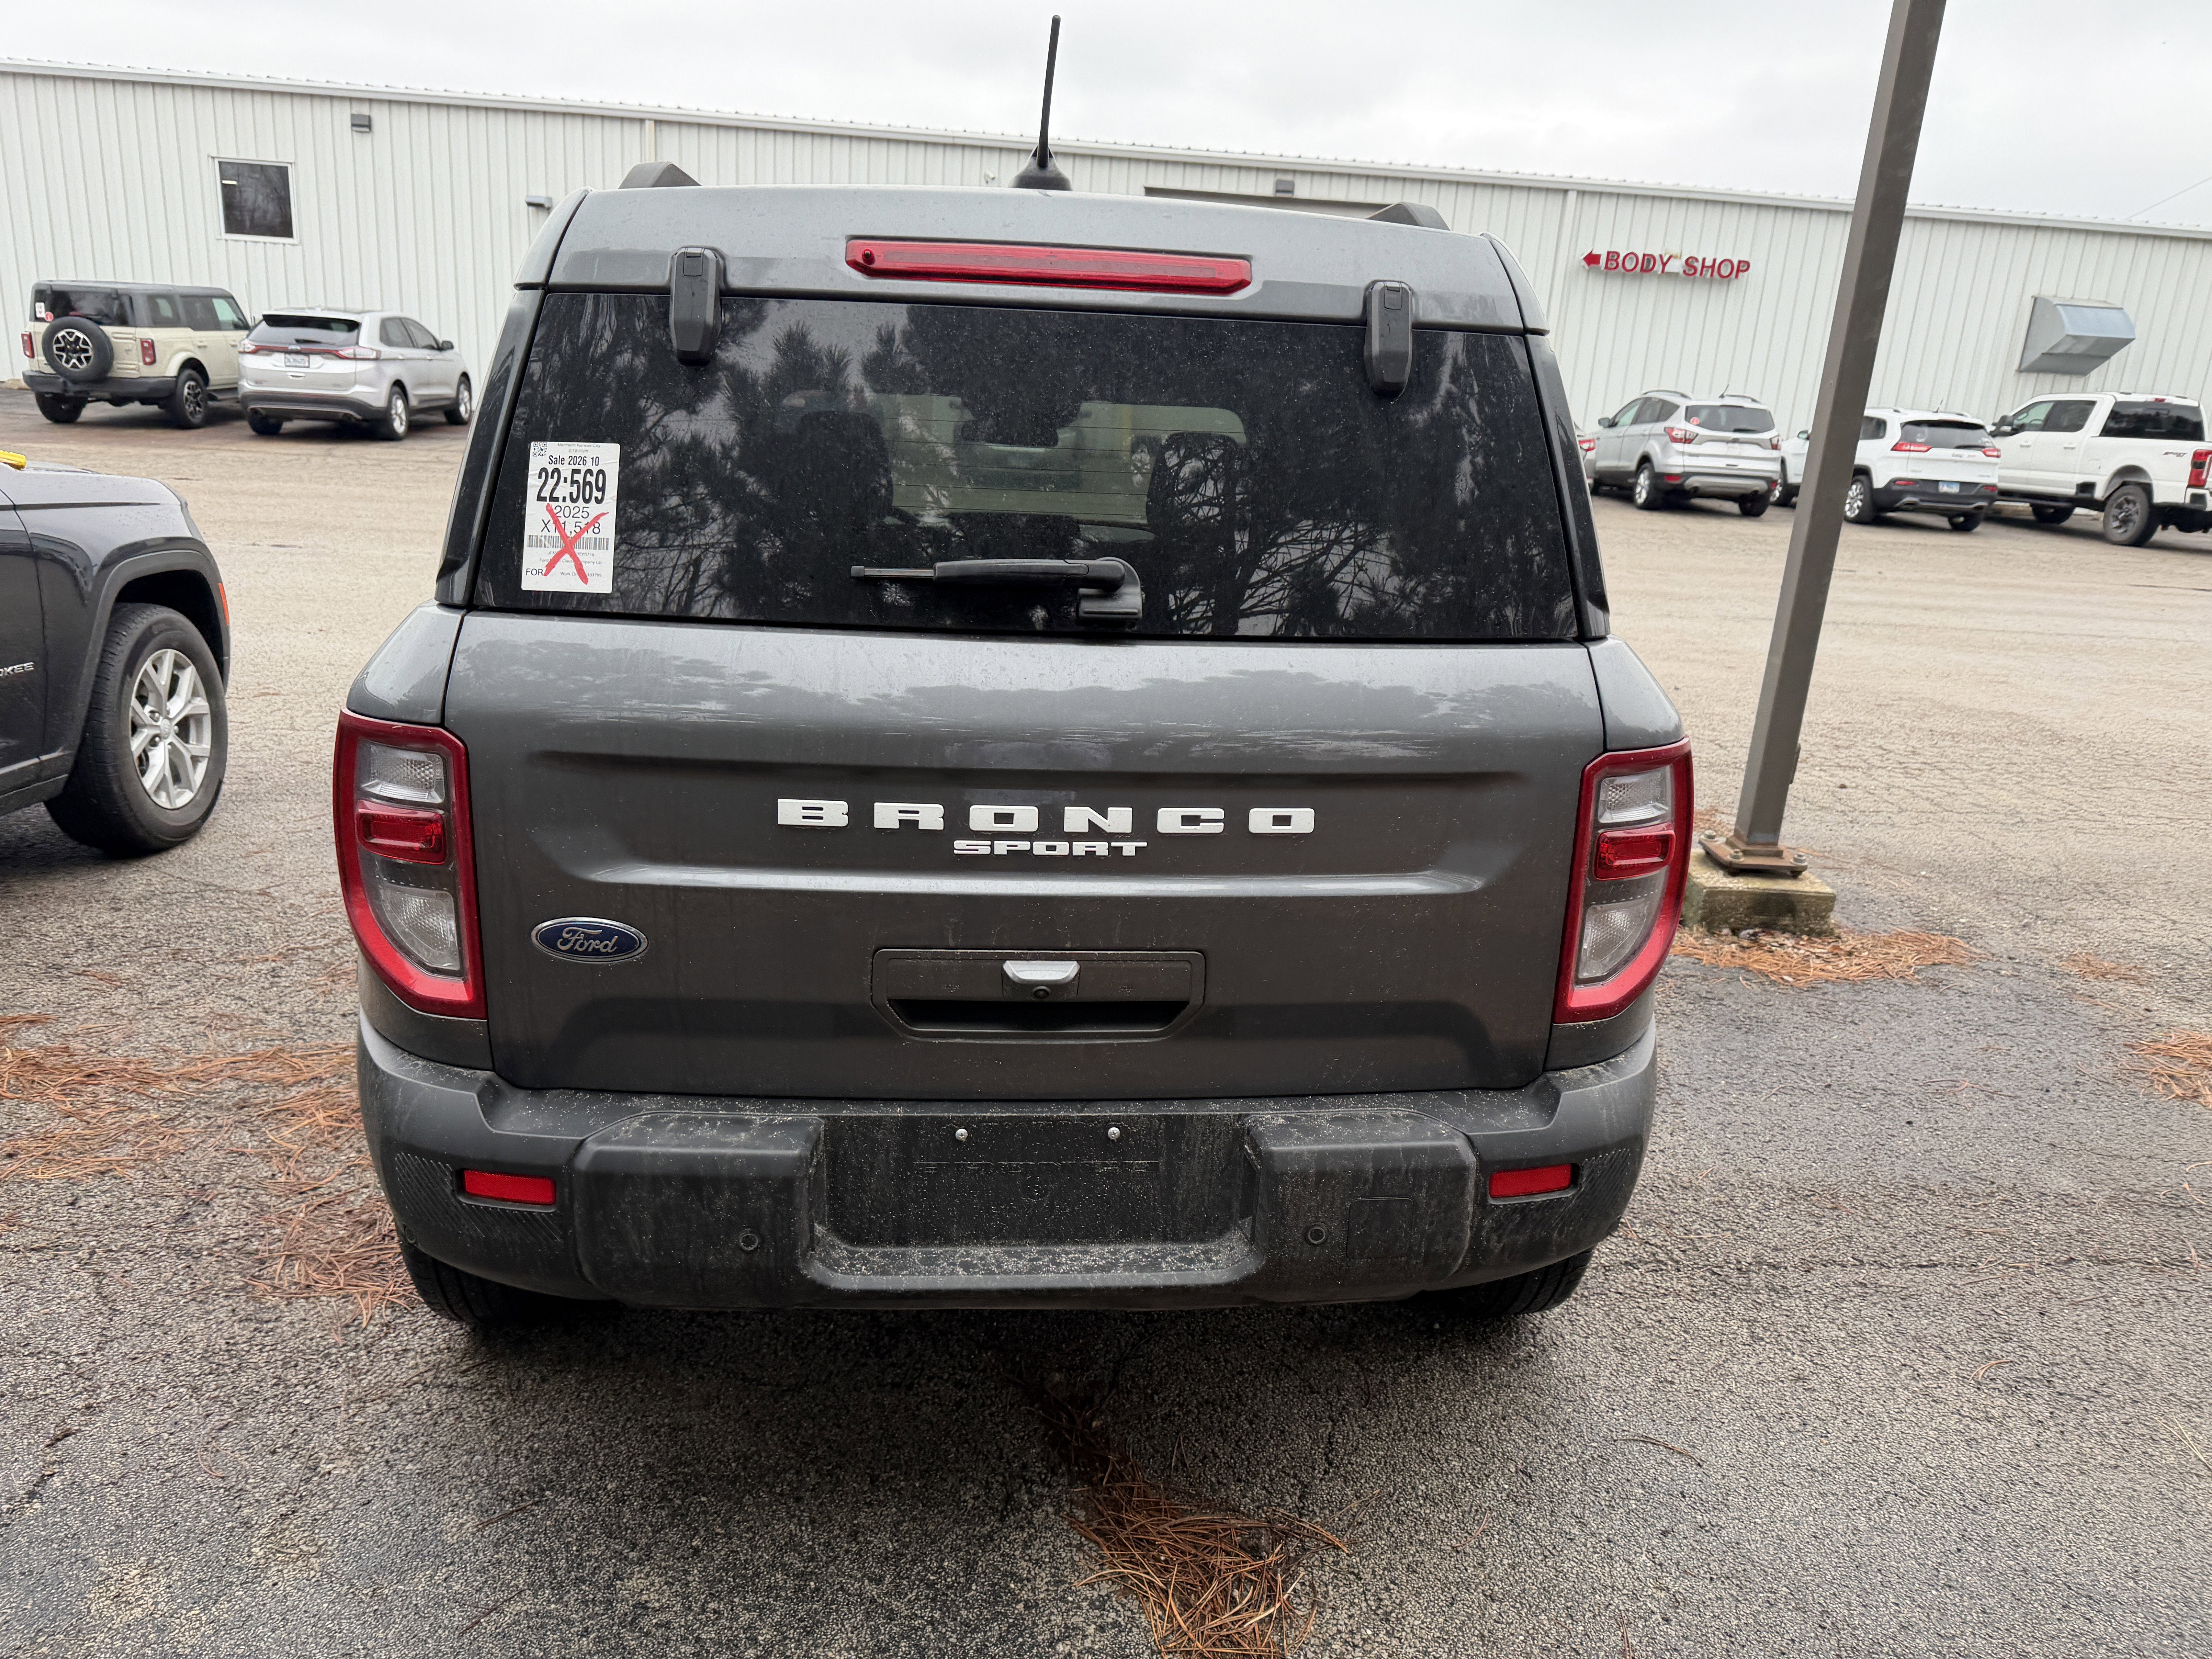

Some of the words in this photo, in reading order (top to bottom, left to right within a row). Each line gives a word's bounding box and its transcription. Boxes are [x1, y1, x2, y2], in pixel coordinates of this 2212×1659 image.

[1604, 250, 1673, 274] BODY
[1682, 256, 1751, 279] SHOP
[548, 455, 565, 465] Sale
[568, 456, 587, 466] 2026
[591, 457, 599, 466] 10
[536, 467, 606, 504] 22:569
[554, 505, 589, 519] 2025
[777, 798, 1315, 833] BRONCO
[953, 840, 1147, 856] SPORT
[557, 927, 618, 953] Ford
